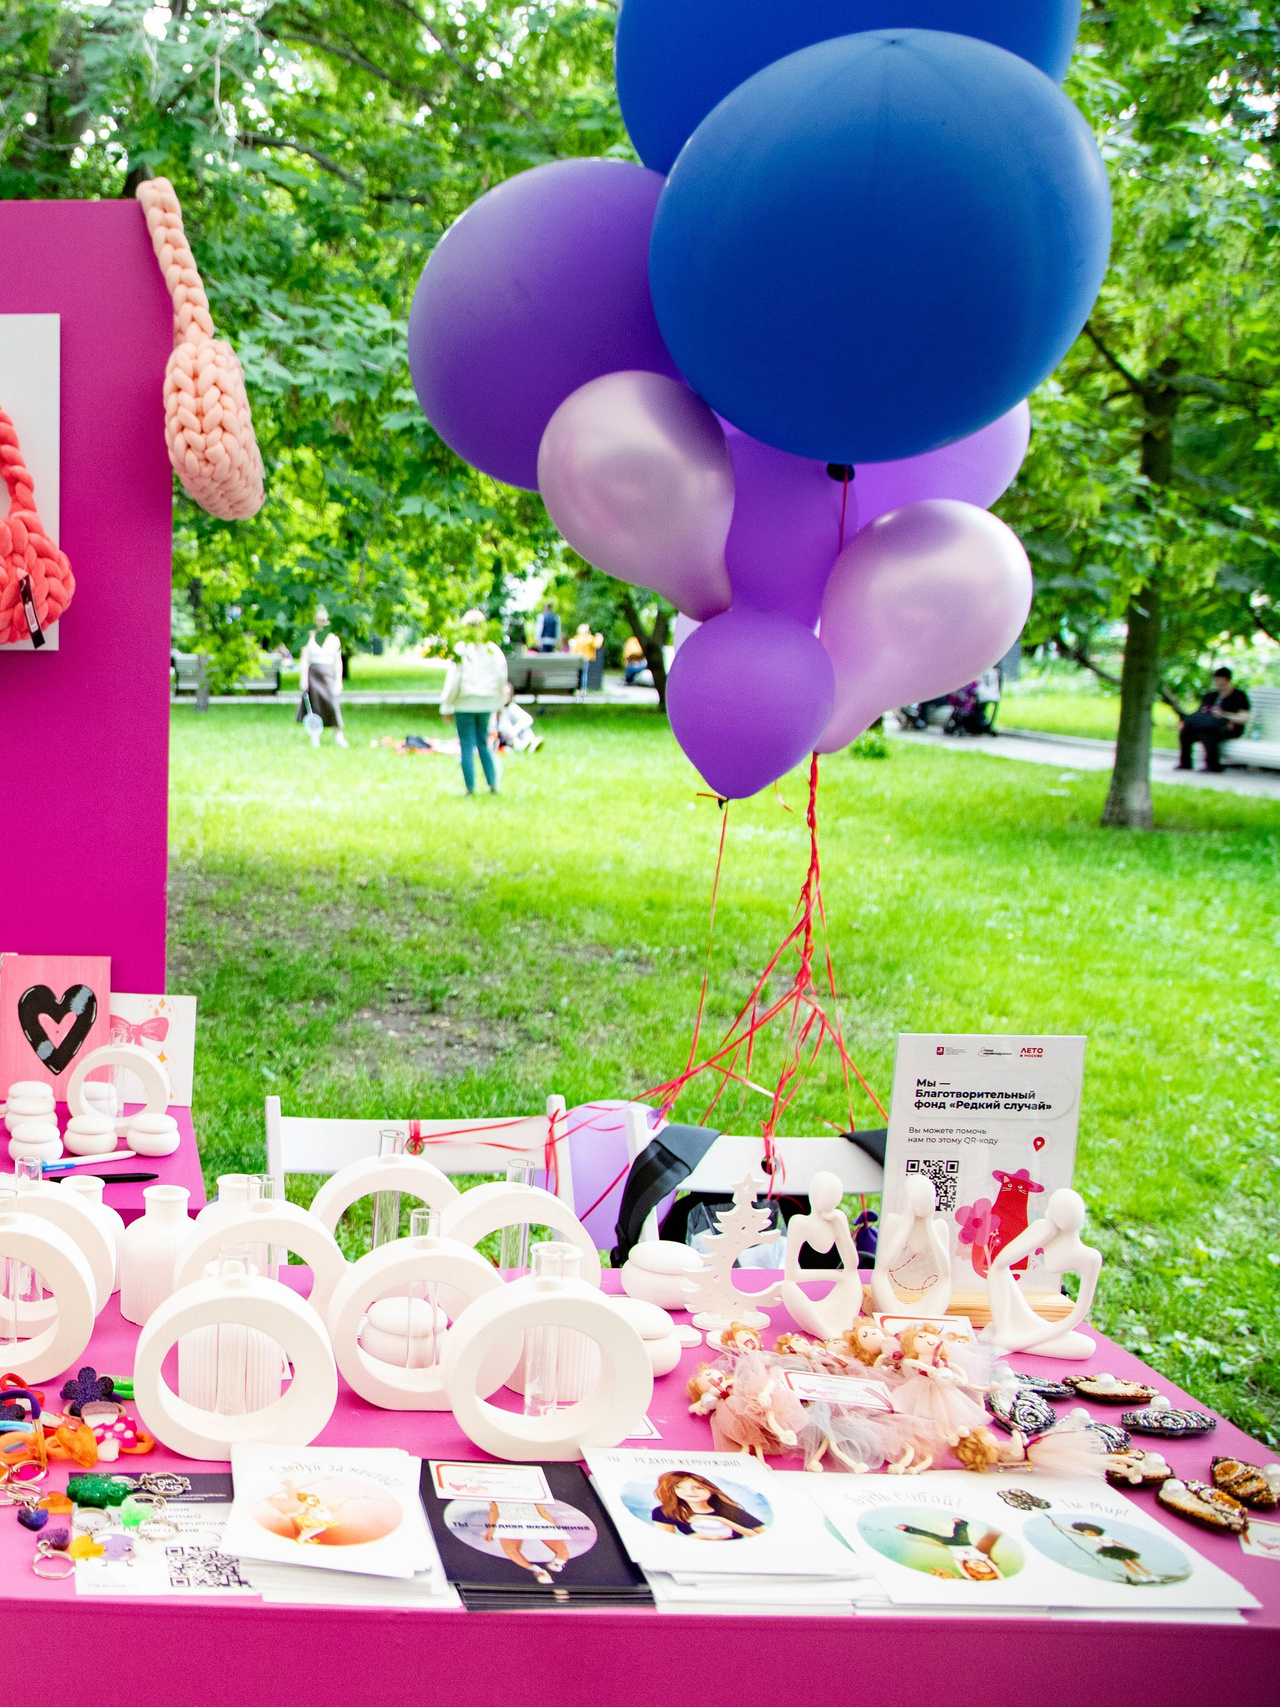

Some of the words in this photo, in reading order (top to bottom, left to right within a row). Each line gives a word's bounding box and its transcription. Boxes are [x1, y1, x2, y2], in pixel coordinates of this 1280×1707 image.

[916, 1079, 936, 1087] Мы
[915, 1089, 1036, 1100] Благотворительный
[914, 1100, 946, 1110] фонд
[949, 1100, 1001, 1110] «Редкий
[1003, 1101, 1052, 1111] случай»
[938, 1137, 962, 1145] этому
[964, 1137, 999, 1145] QR-коду
[329, 1464, 344, 1473] за
